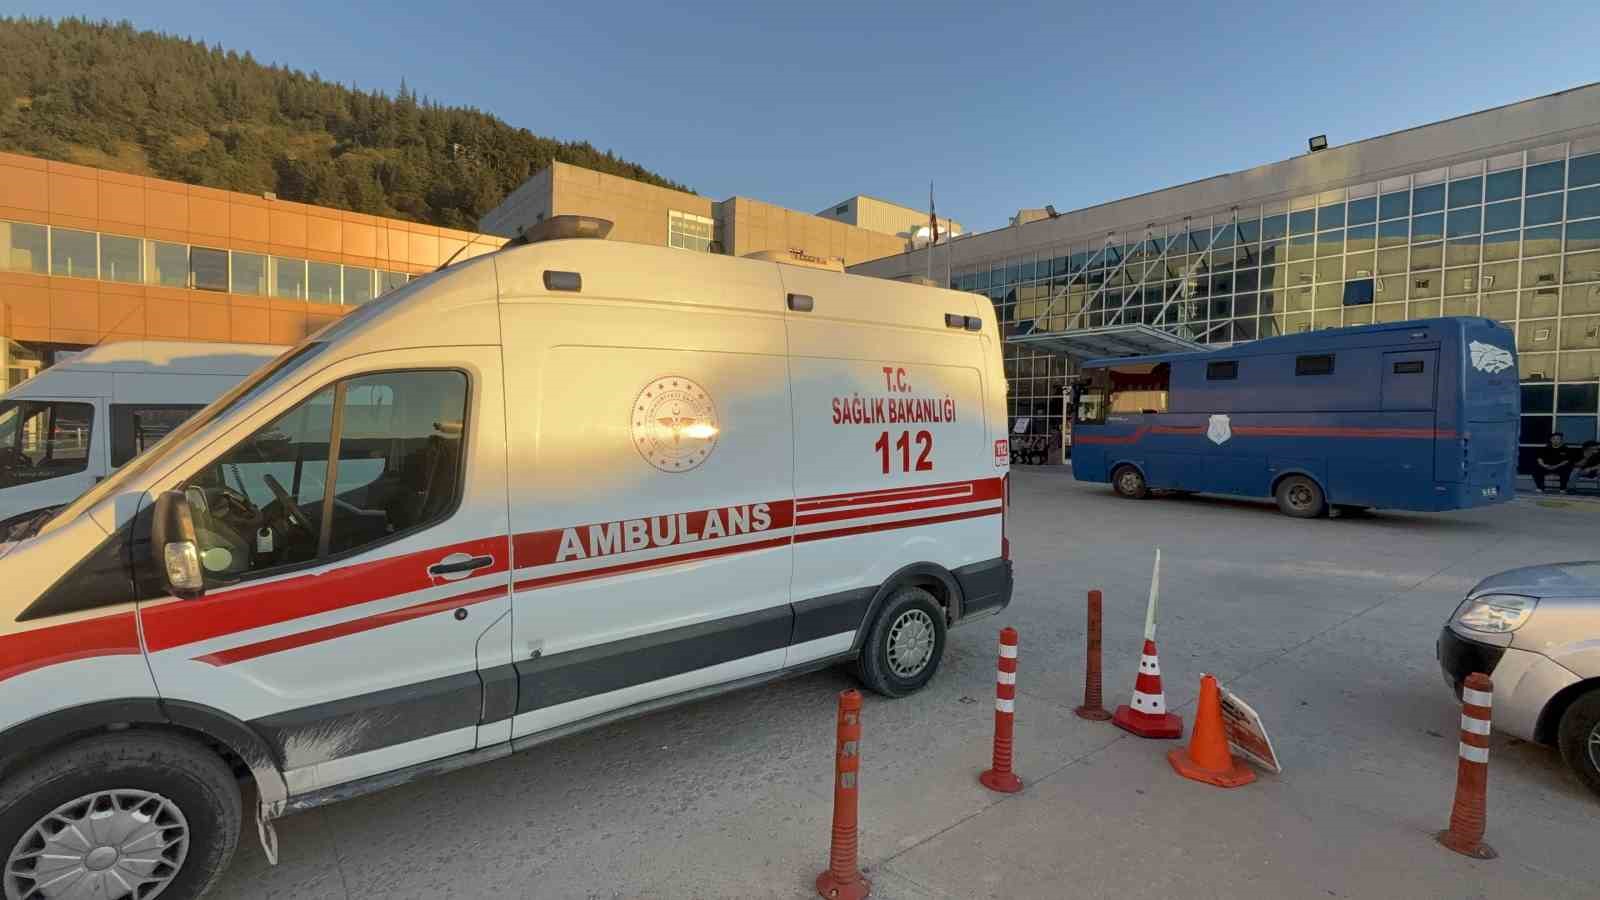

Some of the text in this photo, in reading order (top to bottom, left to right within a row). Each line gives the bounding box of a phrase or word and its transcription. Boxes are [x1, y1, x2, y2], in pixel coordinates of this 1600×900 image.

[882, 367, 912, 393] T.C.
[832, 393, 957, 424] SAĞLIK BAKANLIĞI
[874, 430, 934, 474] 112
[554, 502, 772, 563] AMBULANS
